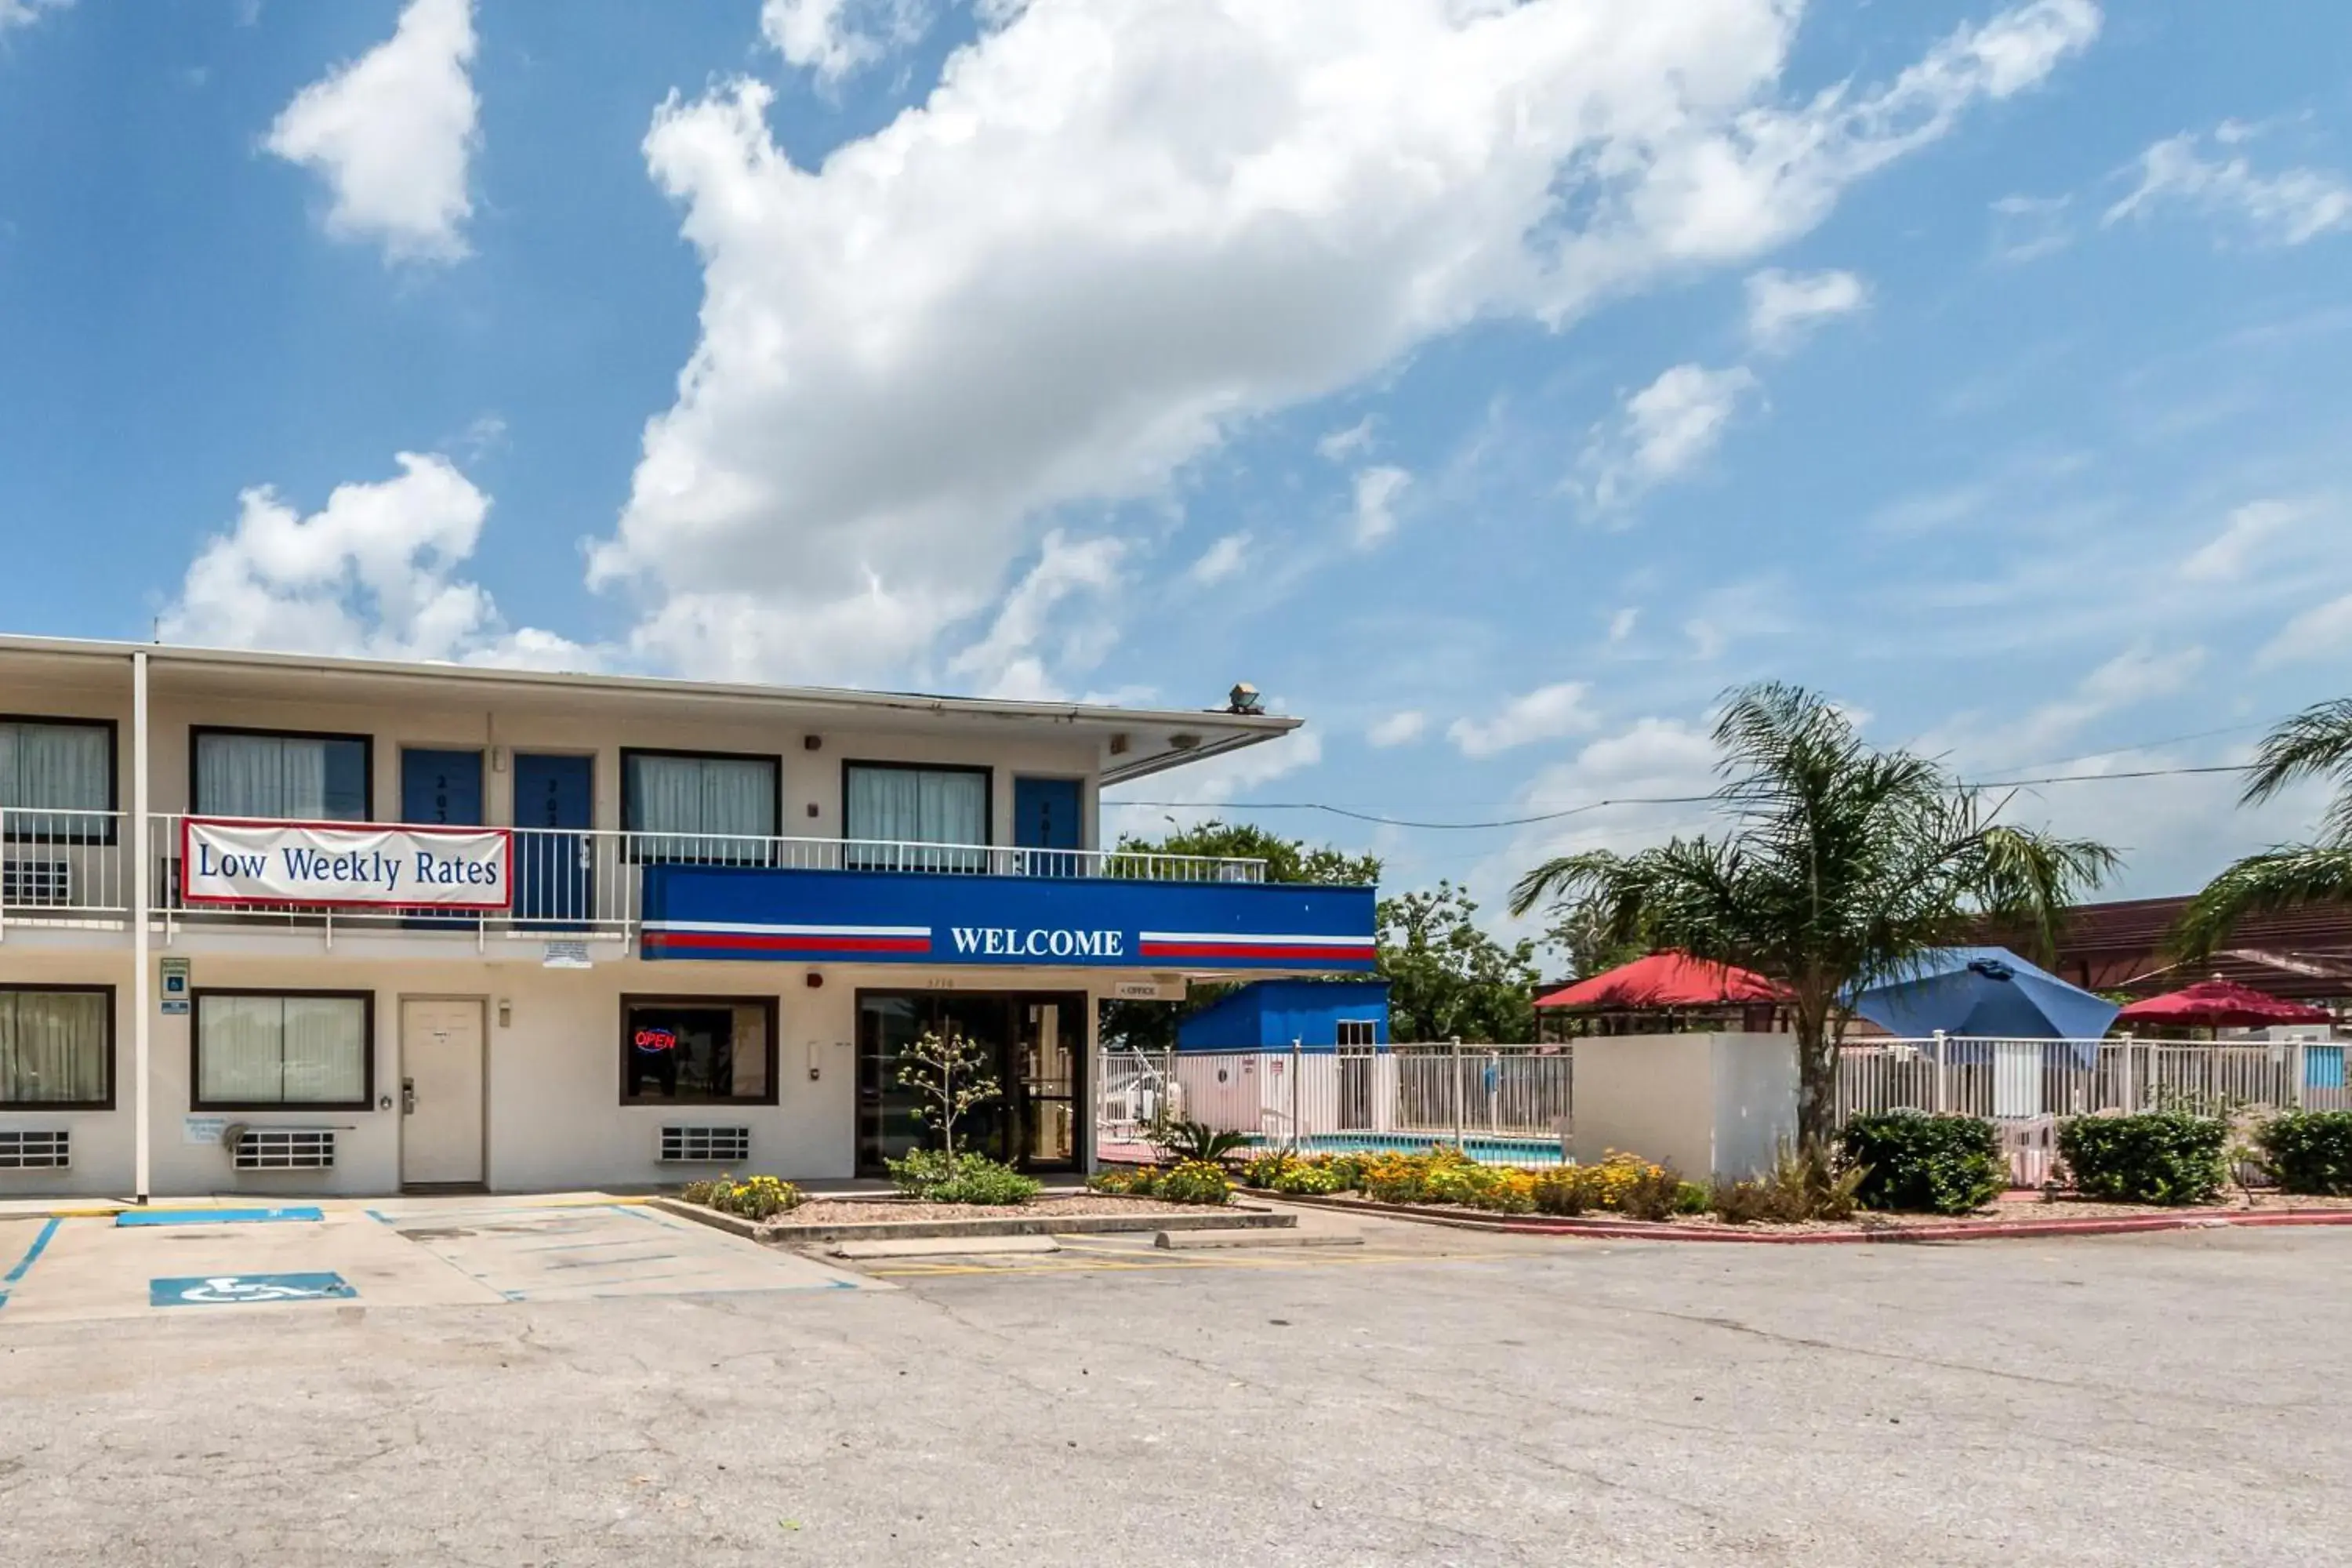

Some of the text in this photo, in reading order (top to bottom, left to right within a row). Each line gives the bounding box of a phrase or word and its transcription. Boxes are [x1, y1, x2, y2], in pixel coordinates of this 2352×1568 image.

[200, 843, 496, 891] Low Weekly Rates
[951, 927, 1123, 956] WELCOME
[635, 1031, 676, 1049] OPEN
